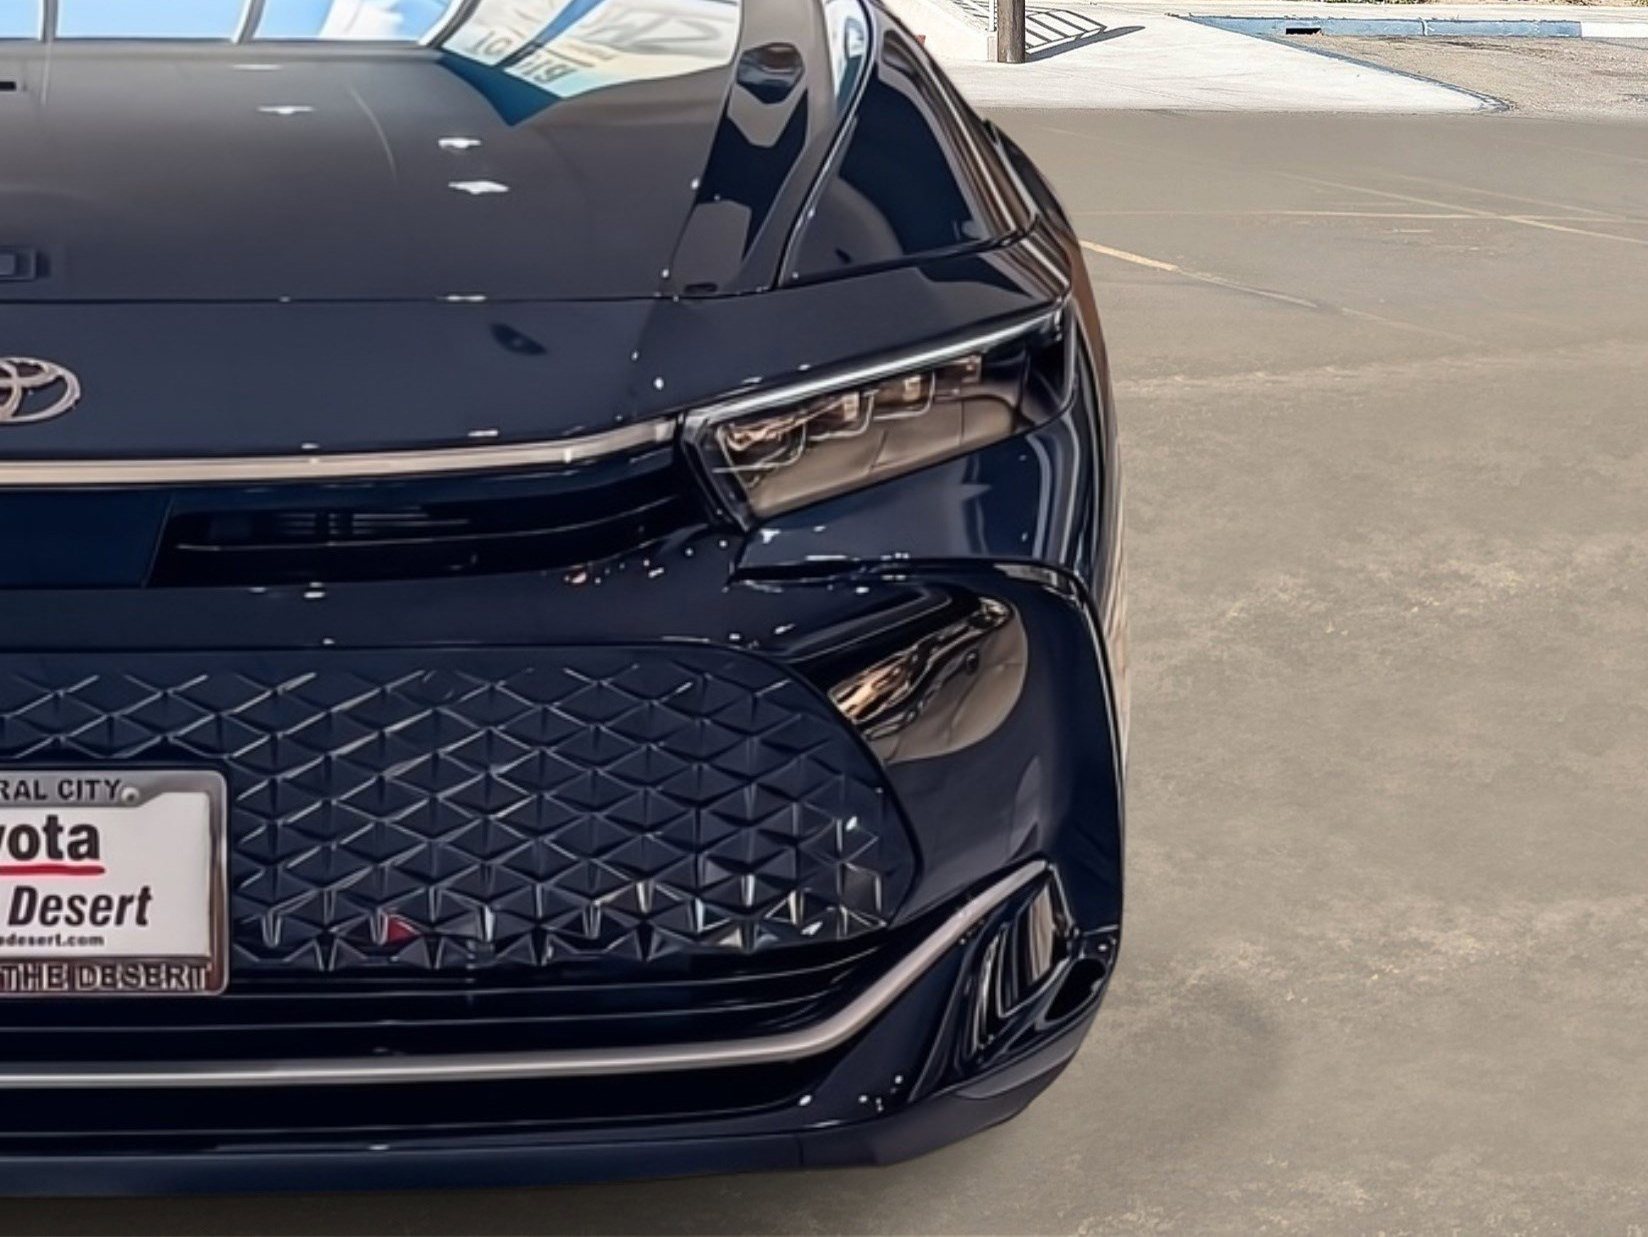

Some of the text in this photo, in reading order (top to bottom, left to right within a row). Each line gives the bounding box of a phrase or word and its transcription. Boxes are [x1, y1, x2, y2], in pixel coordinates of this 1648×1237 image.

[57, 779, 122, 801] CITY
[7, 885, 153, 927] Desert
[75, 964, 211, 992] DESERT
